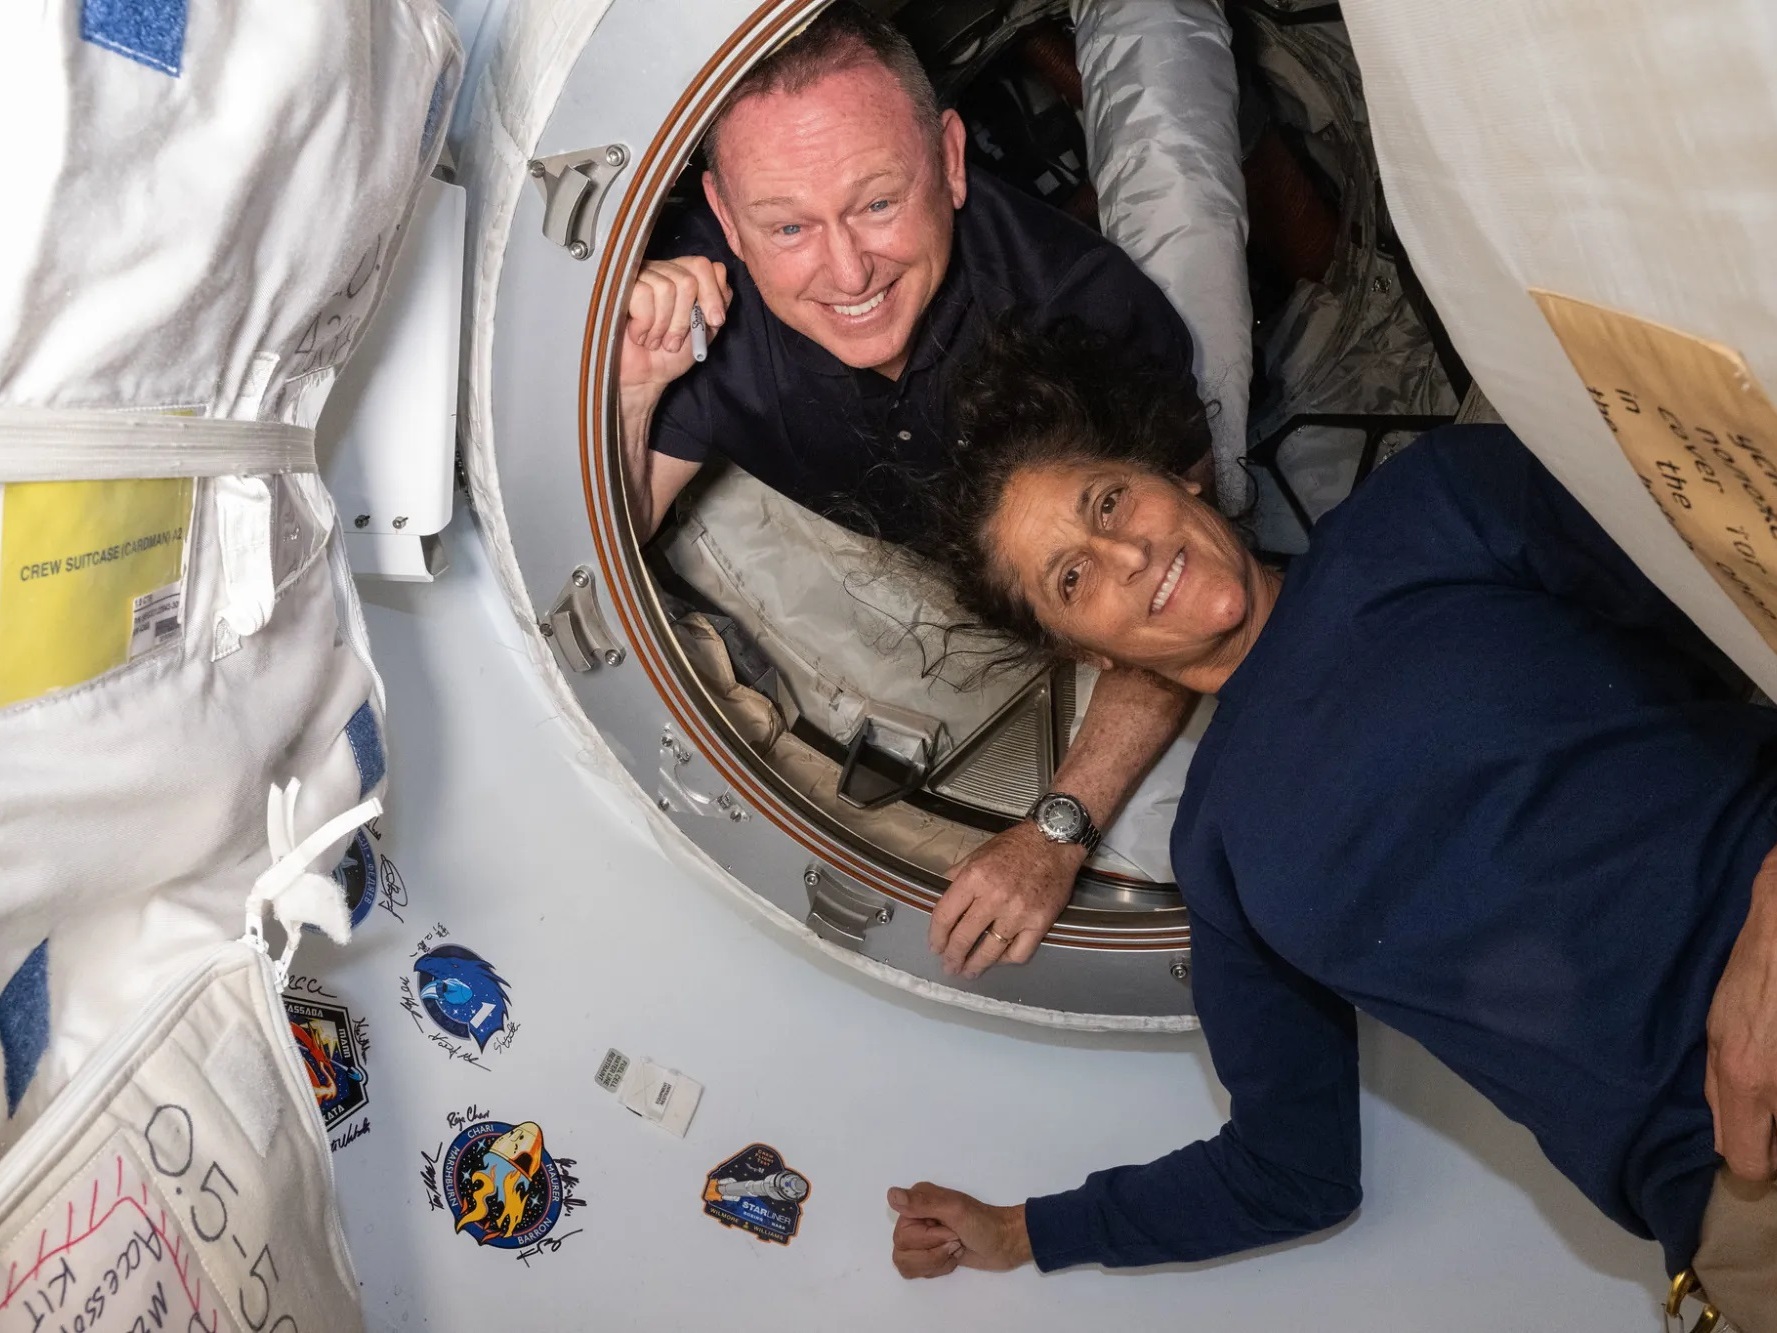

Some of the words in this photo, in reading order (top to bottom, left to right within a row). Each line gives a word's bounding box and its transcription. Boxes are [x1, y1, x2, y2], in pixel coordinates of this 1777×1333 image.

[1615, 388, 1641, 415] in
[1656, 460, 1692, 510] the
[1657, 406, 1724, 494] cover
[20, 558, 62, 581] CREW
[65, 545, 121, 573] SUITCASE
[121, 531, 171, 558] (CARDMAN)
[364, 863, 376, 904] ФЕДЯЕВ
[338, 1028, 352, 1059] MANN
[598, 1052, 616, 1080] RESTRAINT
[603, 1073, 612, 1086] LINE
[610, 1056, 622, 1073] WATER
[617, 1060, 627, 1073] FUEL
[610, 1074, 620, 1087] CELL
[467, 1124, 494, 1139] CHARI
[446, 1146, 461, 1207] MARSHBURN
[545, 1163, 560, 1203] MAURER
[710, 1208, 738, 1223] WILMORE
[754, 1225, 784, 1240] WILLIAMS
[742, 1201, 792, 1225] STARLINER
[517, 1218, 553, 1246] BARRON
[24, 1257, 76, 1333] KIT
